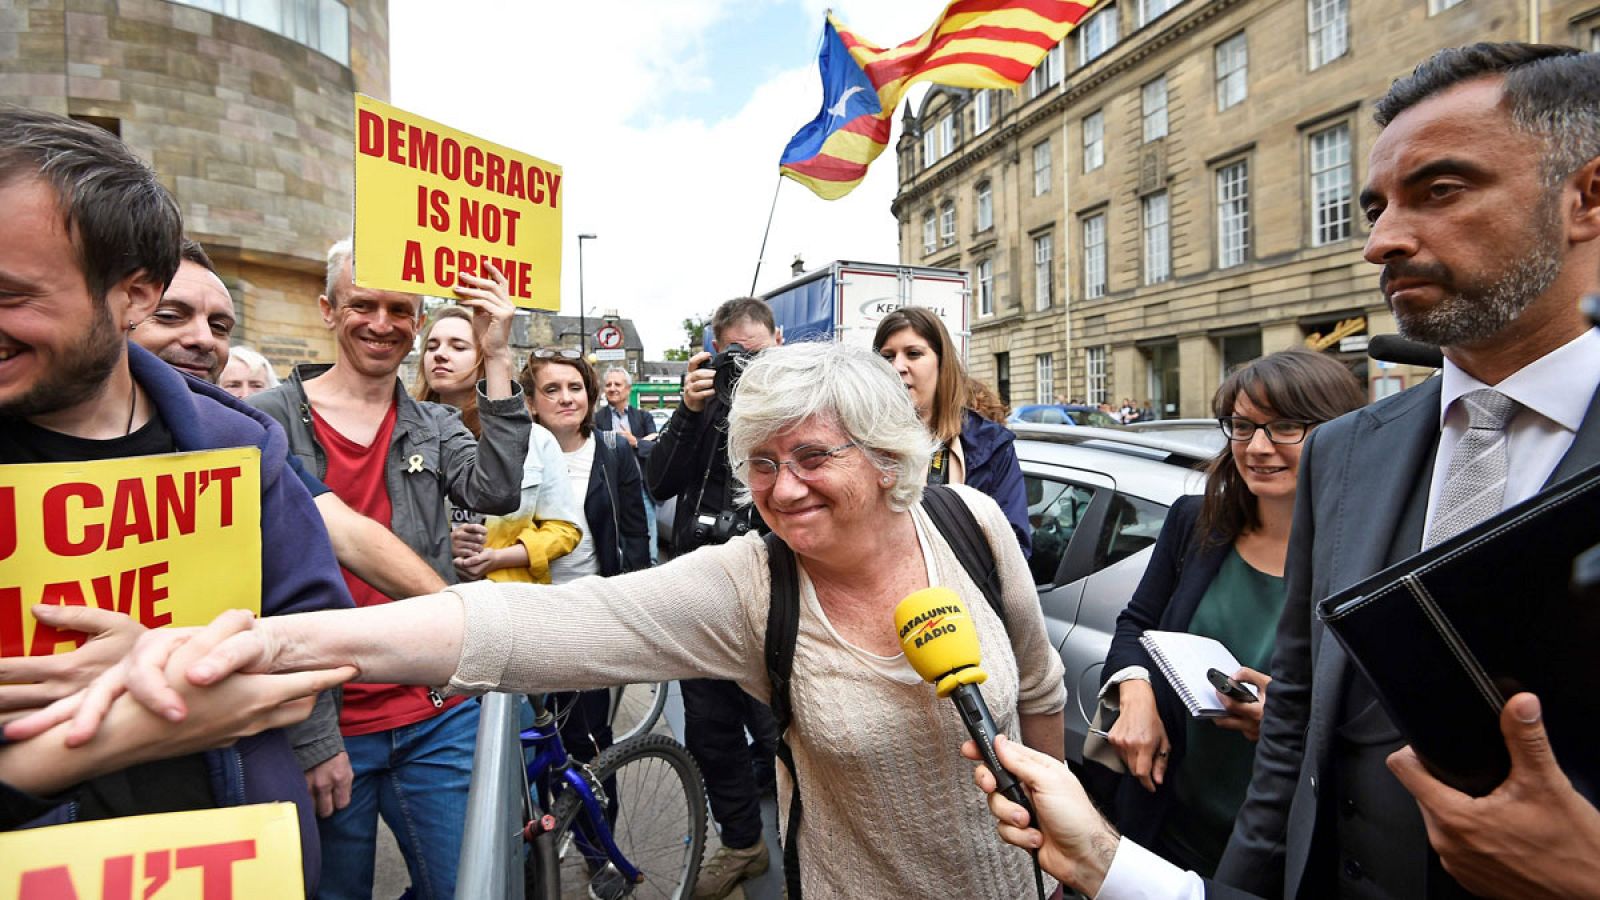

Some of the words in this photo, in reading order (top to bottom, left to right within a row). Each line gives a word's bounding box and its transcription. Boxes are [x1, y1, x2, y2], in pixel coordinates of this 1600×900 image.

[358, 108, 561, 209] DEMOCRACY
[417, 185, 450, 232] IS
[459, 196, 521, 247] NOT
[401, 239, 425, 284] A
[42, 466, 242, 557] CAN'T
[899, 605, 961, 639] CATALUNYA
